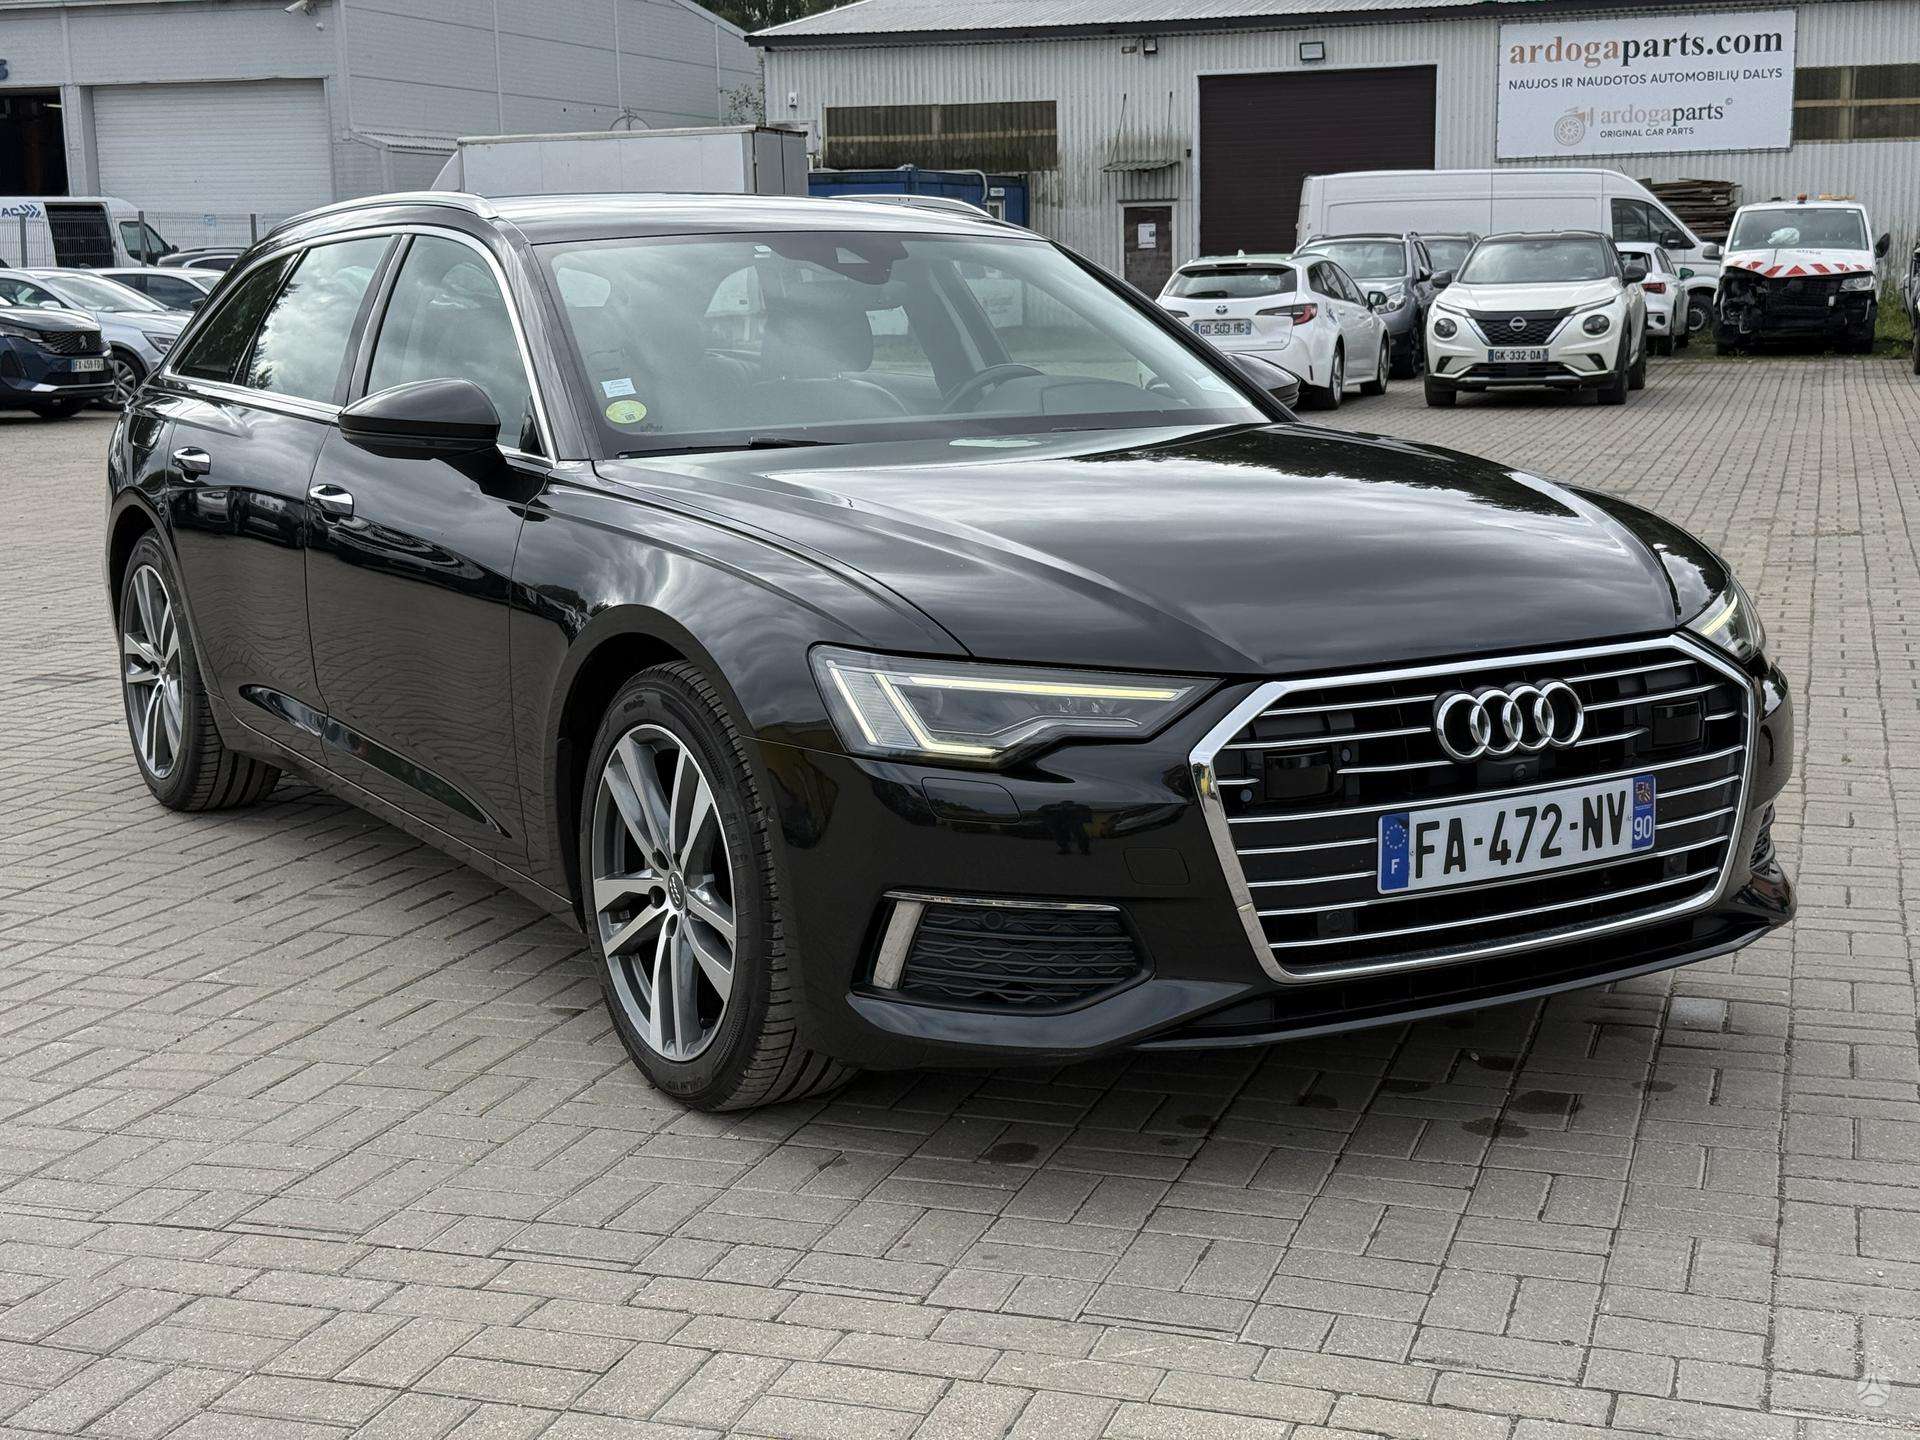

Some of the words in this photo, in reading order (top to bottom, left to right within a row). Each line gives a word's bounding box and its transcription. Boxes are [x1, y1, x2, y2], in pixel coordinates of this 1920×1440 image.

[1510, 32, 1782, 68] ardogaparts.com
[1509, 78, 1558, 90] NAUJOS
[1561, 77, 1572, 88] IR
[1577, 74, 1647, 88] NAUDOTOS
[1650, 69, 1739, 83] AUTOMOBILIŲ
[1743, 67, 1782, 80] DALYS
[1600, 129, 1642, 138] ORIGINAL
[1645, 128, 1663, 137] CAR
[1666, 126, 1694, 136] PARTS
[1415, 790, 1627, 879] FA-472-NV
[1634, 815, 1653, 841] 90
[1391, 858, 1400, 874] F
